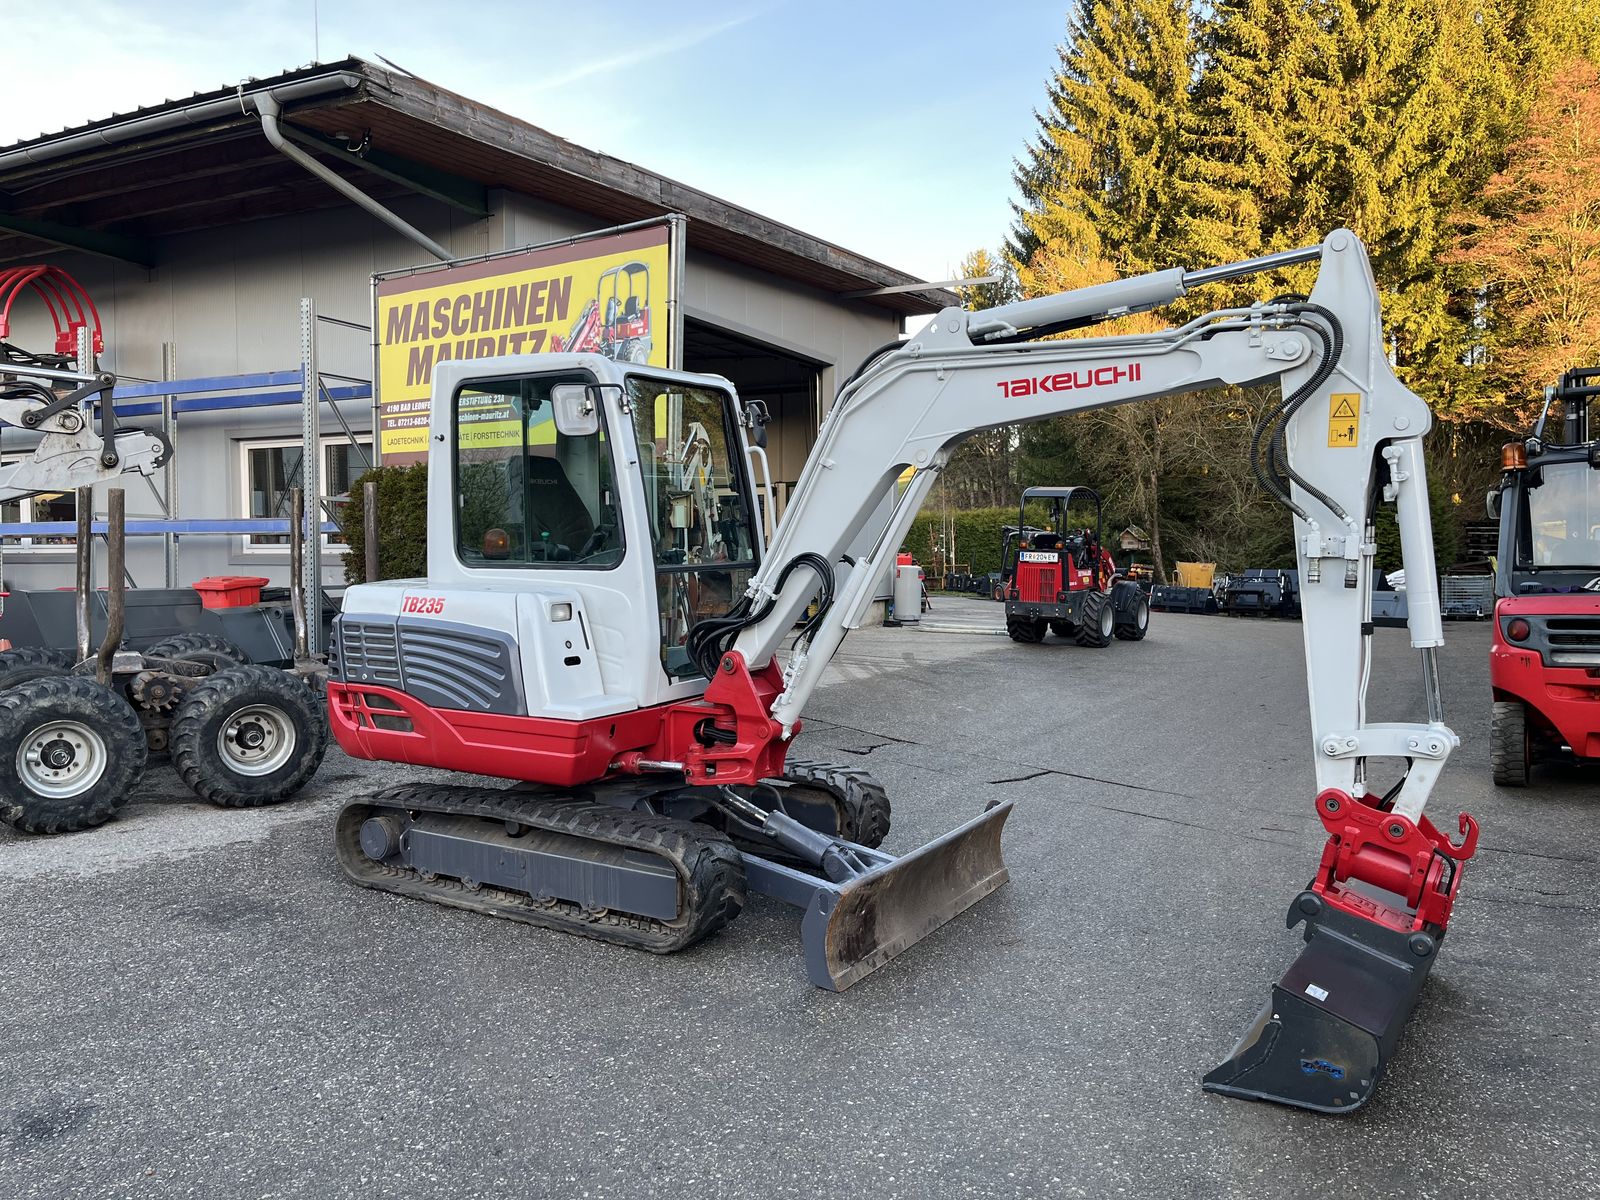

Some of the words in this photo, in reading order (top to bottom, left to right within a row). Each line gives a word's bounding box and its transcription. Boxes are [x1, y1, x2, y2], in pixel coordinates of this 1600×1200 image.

[386, 276, 573, 345] MASCHINEN
[412, 401, 431, 410] LEONFE
[459, 395, 492, 406] ERSTIFTUNG
[459, 410, 510, 421] schinen-mauritz.at
[388, 436, 424, 446] LADETECHNIK
[473, 429, 520, 440] FORSTTECHNIK
[402, 596, 446, 615] TB235
